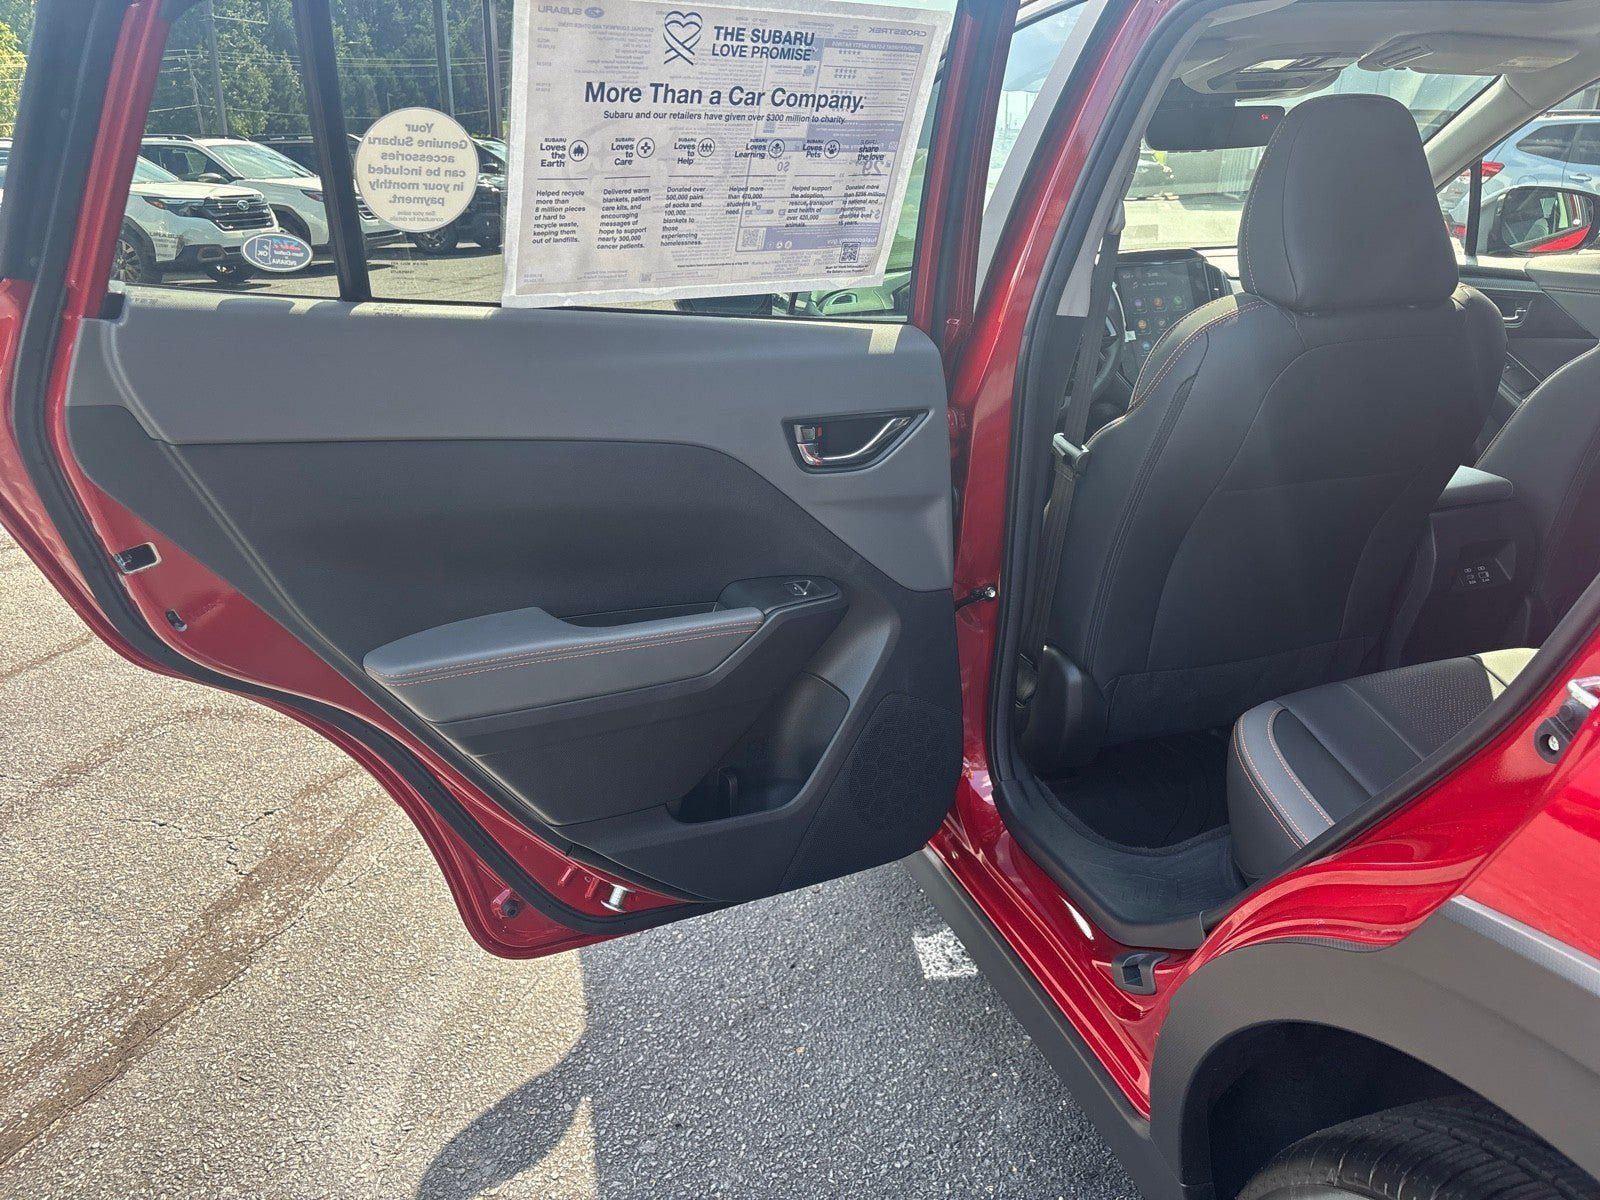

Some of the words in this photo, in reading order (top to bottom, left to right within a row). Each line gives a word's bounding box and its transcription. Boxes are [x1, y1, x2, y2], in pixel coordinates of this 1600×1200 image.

[714, 26, 745, 42] THE
[750, 28, 815, 46] SUBARU
[712, 44, 747, 57] LOVE
[584, 82, 642, 103] More
[650, 83, 702, 104] Than
[709, 90, 721, 105] a
[728, 86, 765, 106] Car
[770, 87, 865, 113] Company.
[603, 110, 634, 120] Subaru
[636, 111, 651, 120] and
[653, 112, 667, 120] our
[669, 111, 702, 121] retailers
[704, 112, 723, 121] have
[726, 113, 746, 123] given
[748, 114, 765, 122] over
[766, 113, 784, 123] $300
[786, 114, 810, 123] million
[811, 115, 819, 123] to
[820, 115, 847, 125] charity.
[540, 143, 566, 151] Loves
[611, 143, 634, 151] Loves
[674, 142, 696, 150] Loves
[734, 151, 766, 159] Learning
[614, 158, 633, 166] Care
[677, 158, 694, 166] Help
